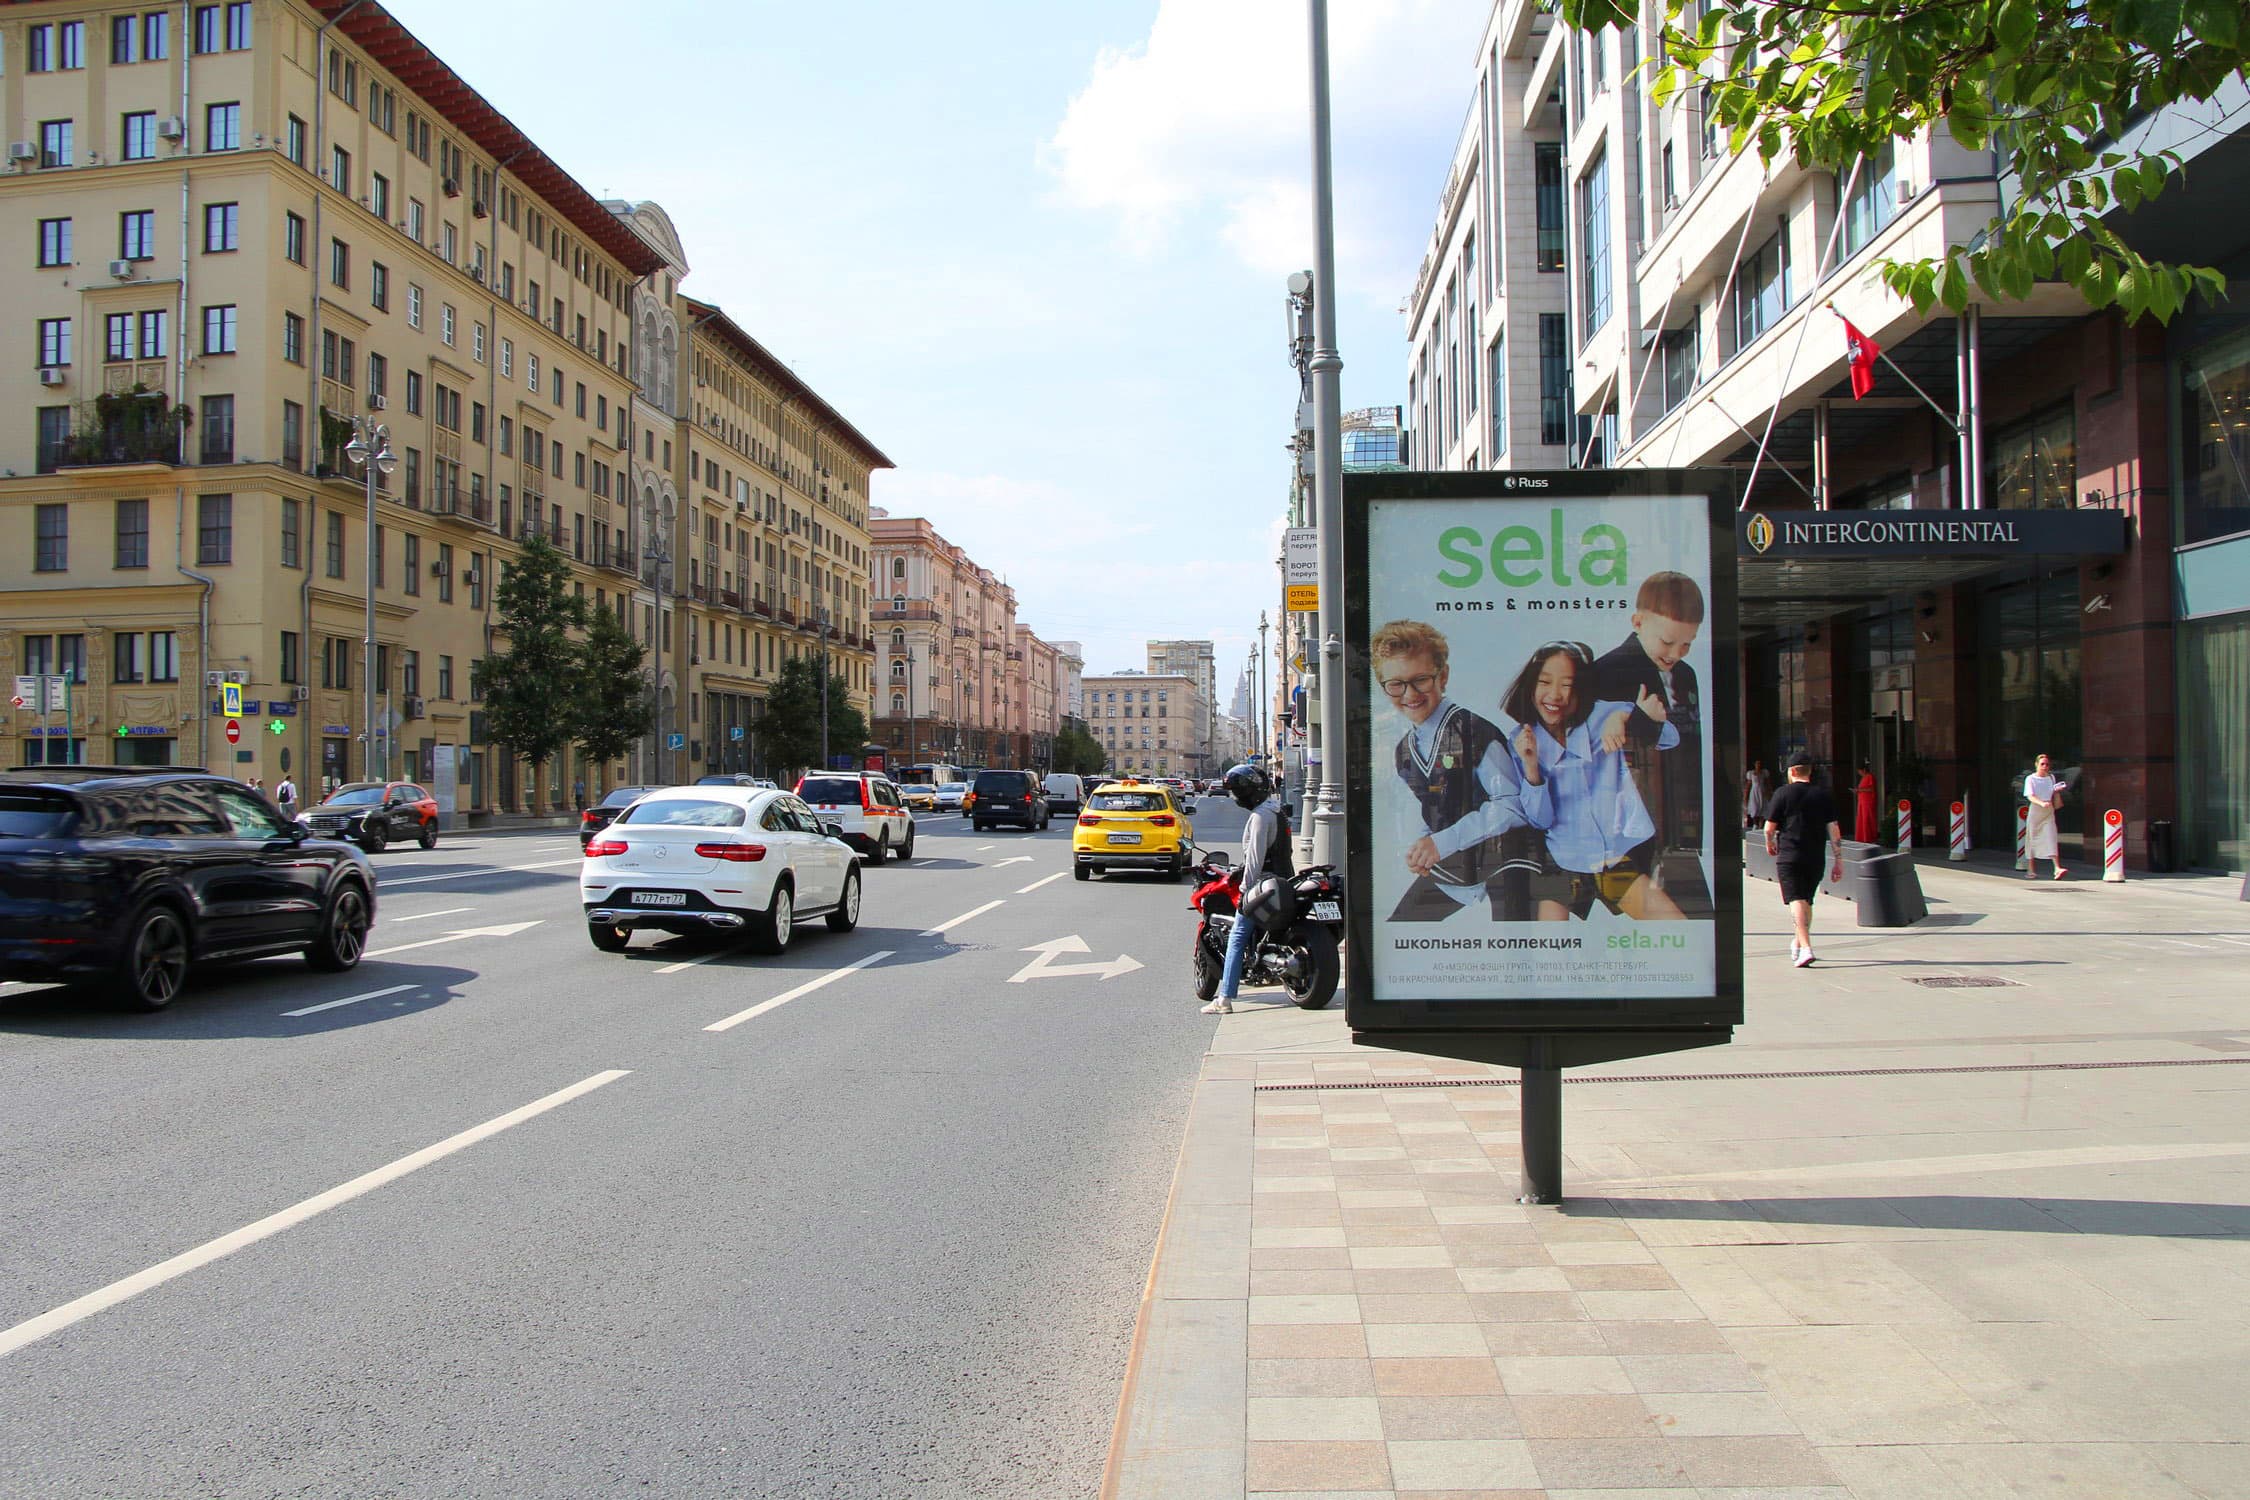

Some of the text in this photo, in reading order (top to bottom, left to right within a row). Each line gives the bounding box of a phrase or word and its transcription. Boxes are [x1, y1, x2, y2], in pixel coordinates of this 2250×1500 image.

[1518, 477, 1549, 488] Russ
[1437, 508, 1628, 589] sela
[1436, 597, 1628, 611] moms & monsters
[1394, 937, 1582, 951] школьная коллекция
[1606, 929, 1686, 948] sela.ru
